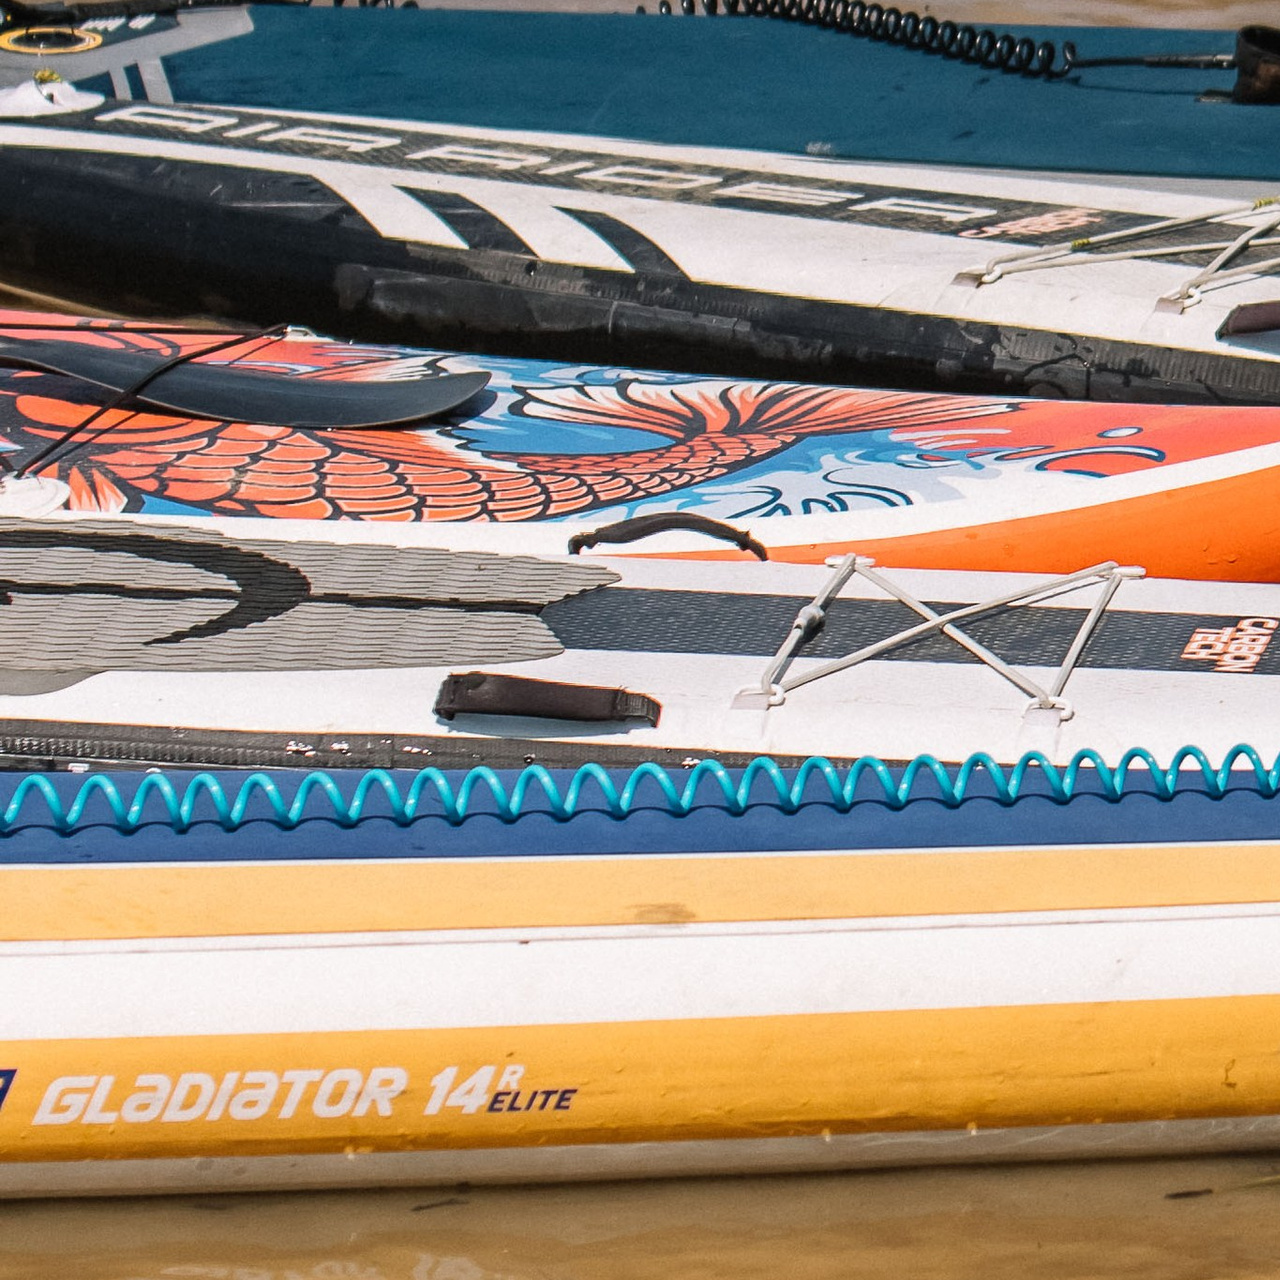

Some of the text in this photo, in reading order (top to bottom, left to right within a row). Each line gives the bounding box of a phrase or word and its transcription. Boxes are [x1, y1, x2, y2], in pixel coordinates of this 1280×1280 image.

[94, 104, 998, 222] AIR RIDER
[1179, 627, 1238, 660] TECH
[1214, 617, 1280, 672] CARBON
[486, 1088, 578, 1113] ELITE
